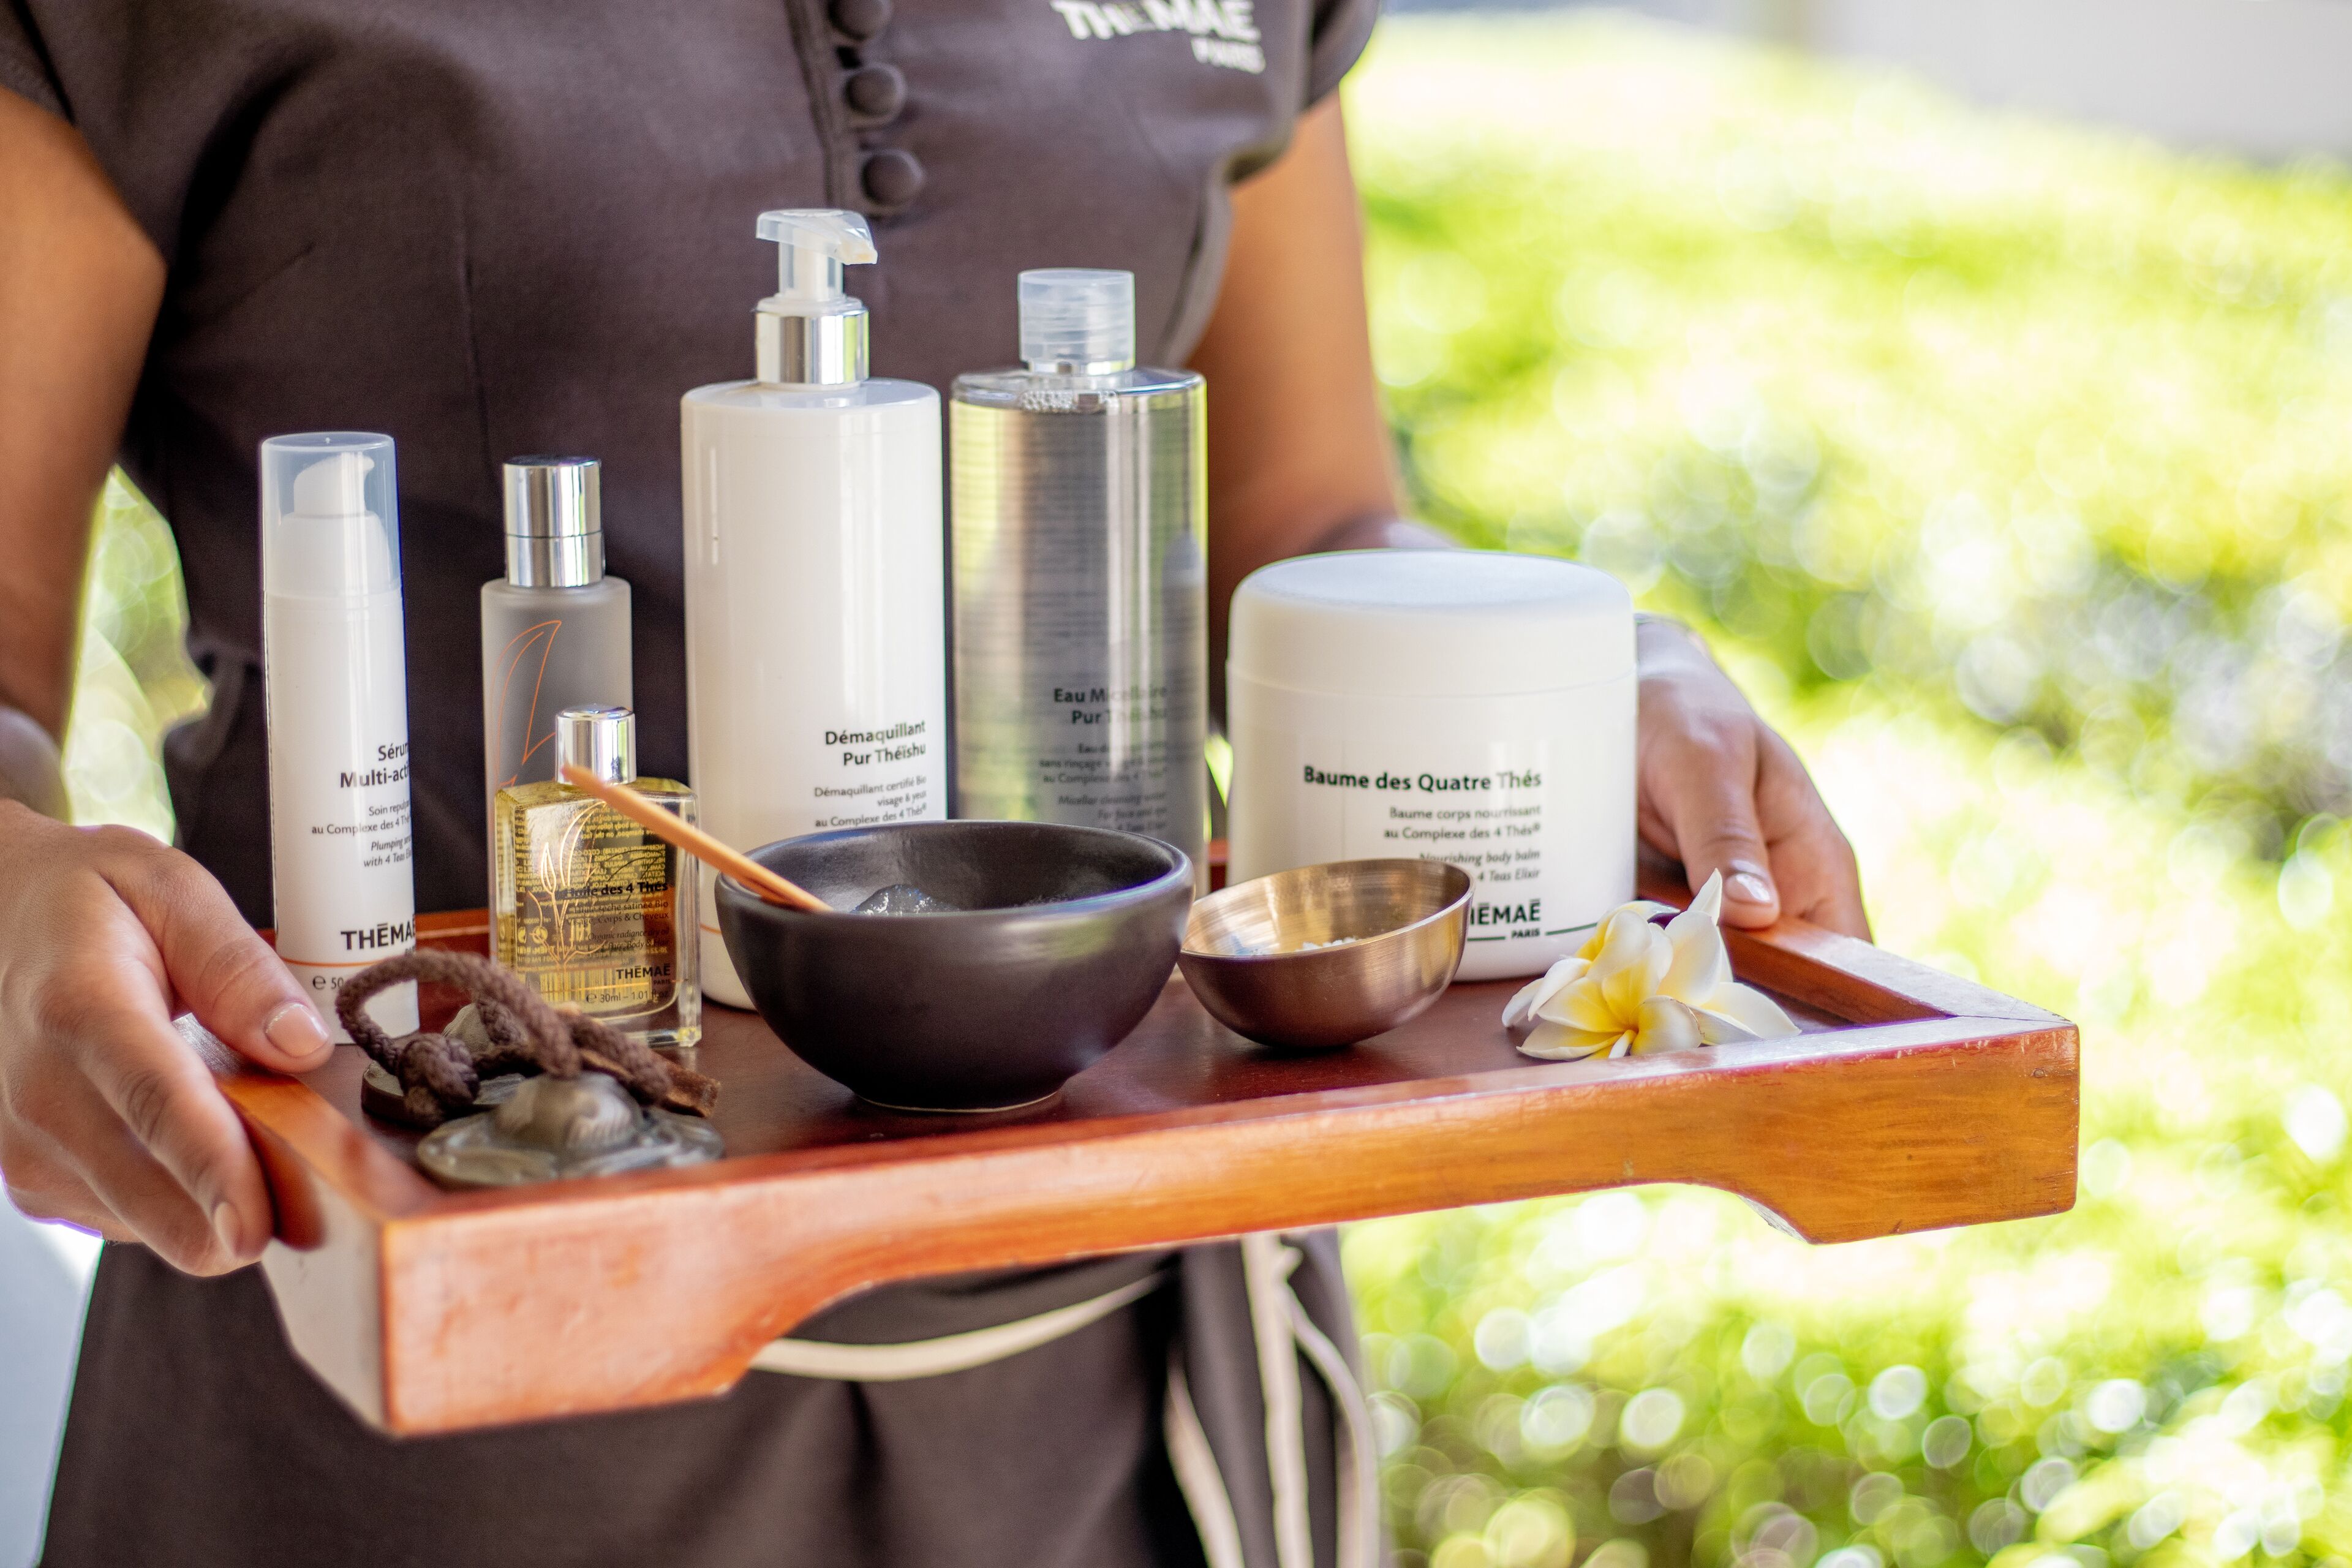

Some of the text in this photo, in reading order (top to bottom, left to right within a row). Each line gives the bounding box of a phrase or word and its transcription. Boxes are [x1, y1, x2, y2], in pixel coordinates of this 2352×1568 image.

[1053, 688, 1085, 703] Eau
[1071, 710, 1102, 724] Pur
[825, 720, 925, 745] Démaquillant
[843, 752, 872, 766] Pur
[1303, 764, 1542, 794] Baume des Quatre Thés
[814, 775, 927, 798] Démaquillant certifié Bio
[877, 794, 903, 808] visage
[368, 805, 388, 816] Soin
[1389, 805, 1541, 823] Baume corps nourrissant
[815, 819, 827, 827] au
[831, 814, 880, 828] Complexe
[882, 810, 897, 822] des
[899, 809, 904, 818] 4
[311, 826, 323, 834] au
[326, 822, 377, 837] Complexe
[380, 819, 394, 831] des
[395, 817, 400, 826] 4
[1384, 829, 1398, 839] au
[1402, 826, 1466, 843] Complexe
[1470, 827, 1490, 839] des
[1494, 827, 1501, 837] 4
[371, 836, 403, 851] Plumping
[363, 857, 383, 867] with
[385, 855, 391, 864] 4
[1486, 852, 1512, 865] body
[1515, 848, 1540, 861] balm
[1477, 868, 1540, 882] 4 Teas Elixir
[601, 884, 622, 895] des
[625, 882, 635, 893] 4
[625, 913, 631, 921] &
[633, 911, 669, 921] Cheveux
[616, 929, 646, 940] radiance
[1510, 928, 1540, 939] PARIS
[627, 939, 644, 949] Body
[600, 992, 621, 1003] 30ml
[631, 990, 648, 1001] 1.01
